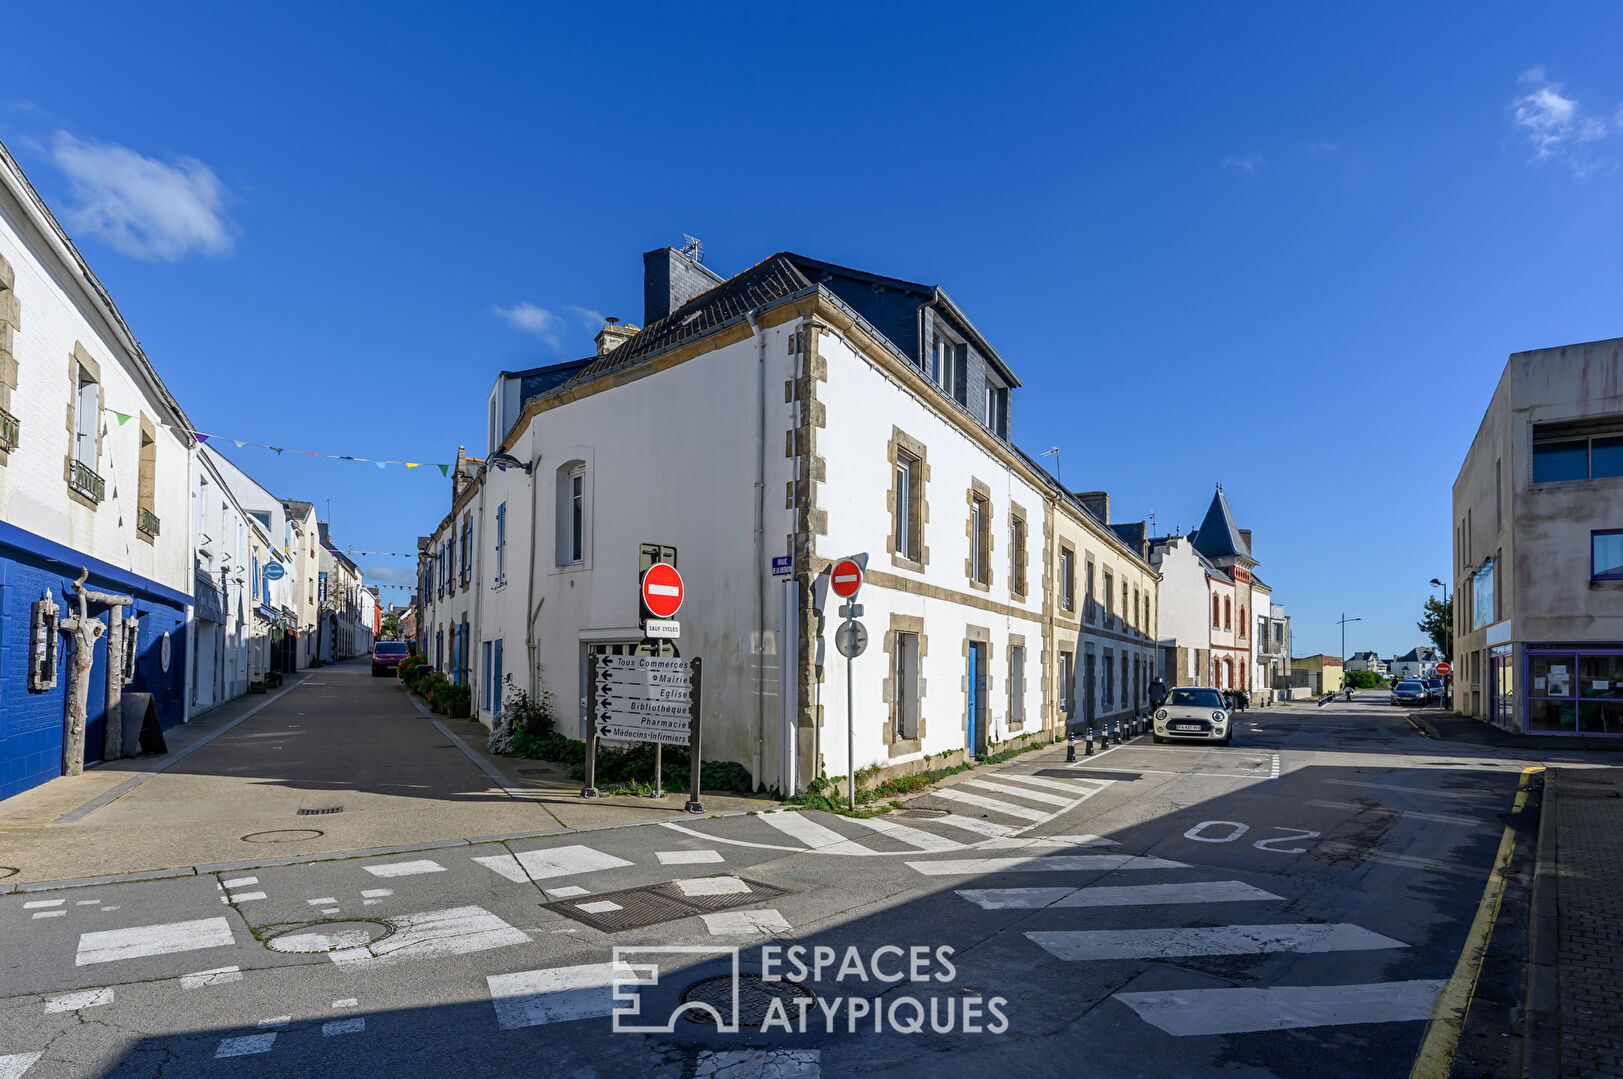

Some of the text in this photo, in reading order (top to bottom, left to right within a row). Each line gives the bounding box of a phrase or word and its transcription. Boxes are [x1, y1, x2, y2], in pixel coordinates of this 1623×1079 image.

[777, 558, 788, 566] RUE
[618, 658, 689, 669] Tous Commerces
[659, 675, 688, 684] Mairie
[660, 689, 688, 699] Eglise
[630, 702, 687, 715] Bibliothèque
[640, 717, 686, 729] Pharmacie
[612, 728, 686, 743] Médecins-Infirmiers
